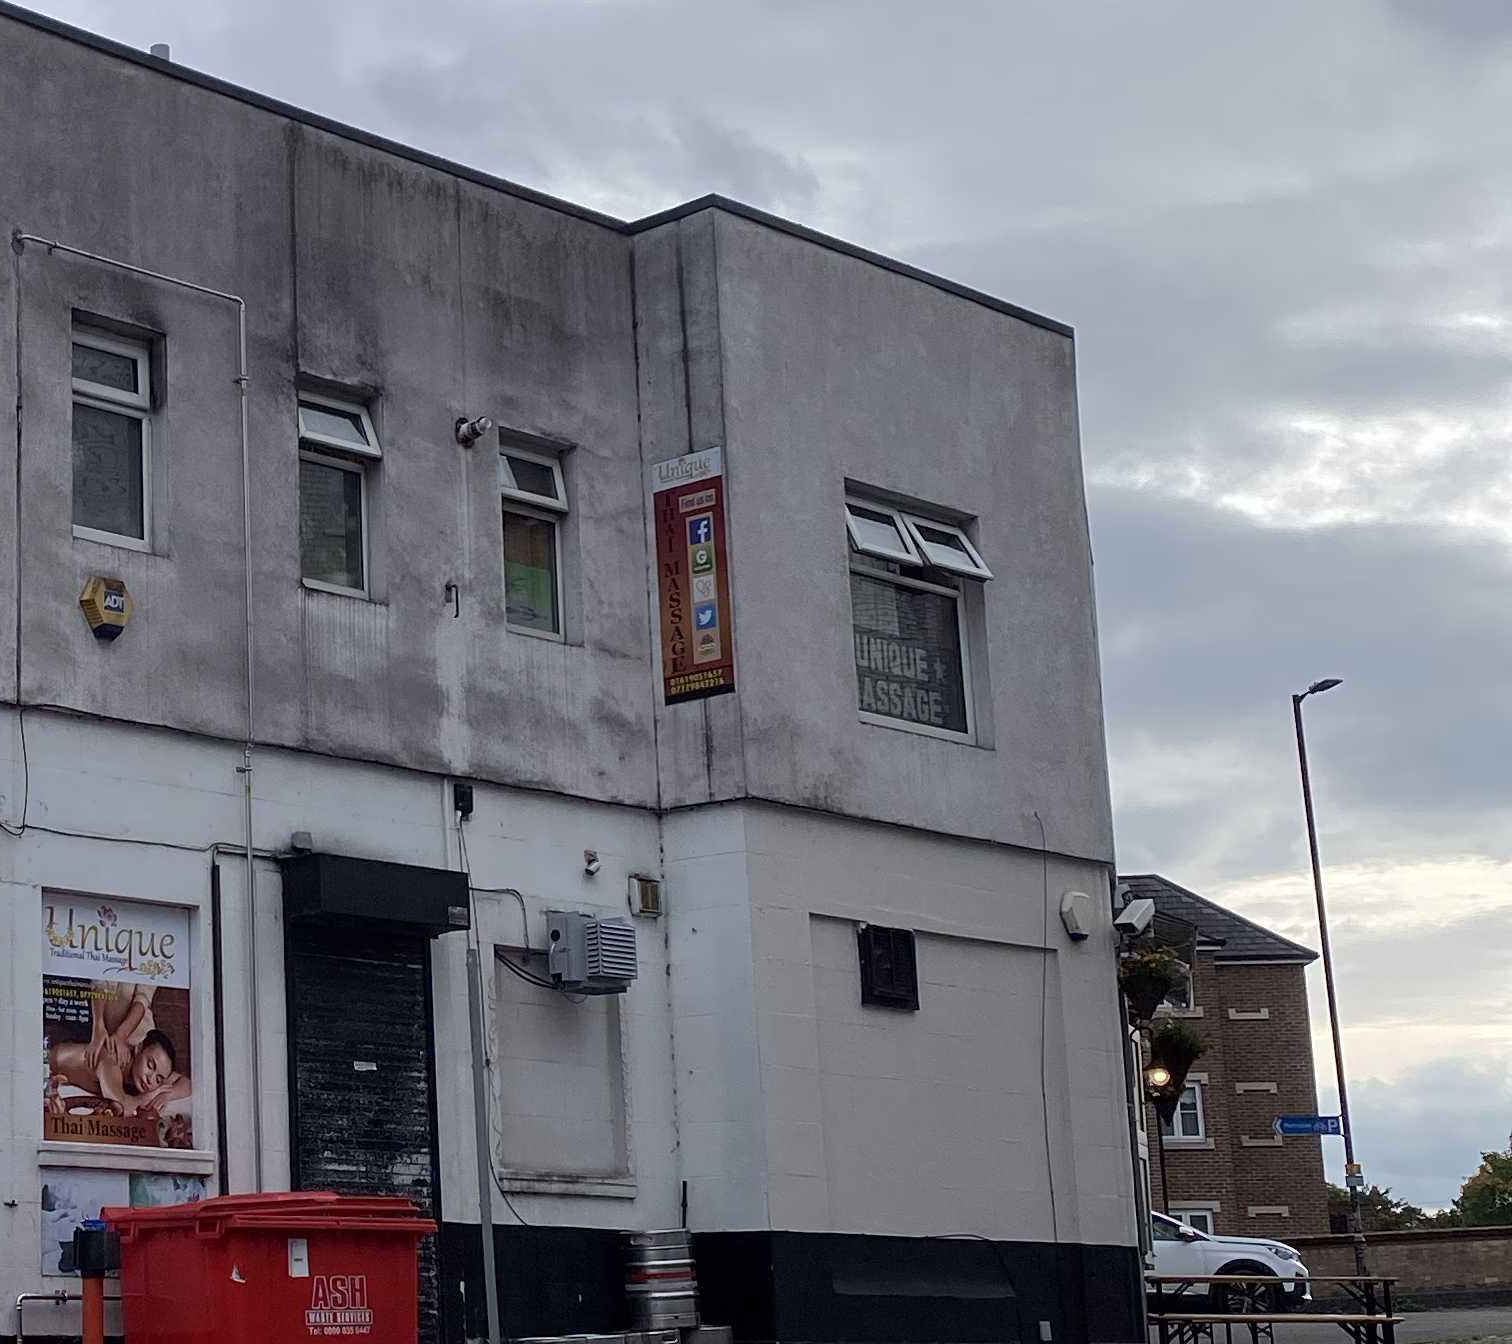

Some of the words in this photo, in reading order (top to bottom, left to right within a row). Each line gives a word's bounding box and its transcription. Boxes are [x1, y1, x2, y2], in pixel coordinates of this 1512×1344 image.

[659, 458, 711, 480] Unique
[105, 595, 124, 609] ADT
[664, 560, 686, 674] MASSAGE
[855, 633, 929, 682] UNIQUE
[45, 906, 175, 971] Unique
[51, 1116, 83, 1135] Thai
[88, 1119, 146, 1142] Massage
[1328, 1119, 1338, 1132] P
[311, 1275, 368, 1309] ASH
[336, 1311, 370, 1323] SERVICES
